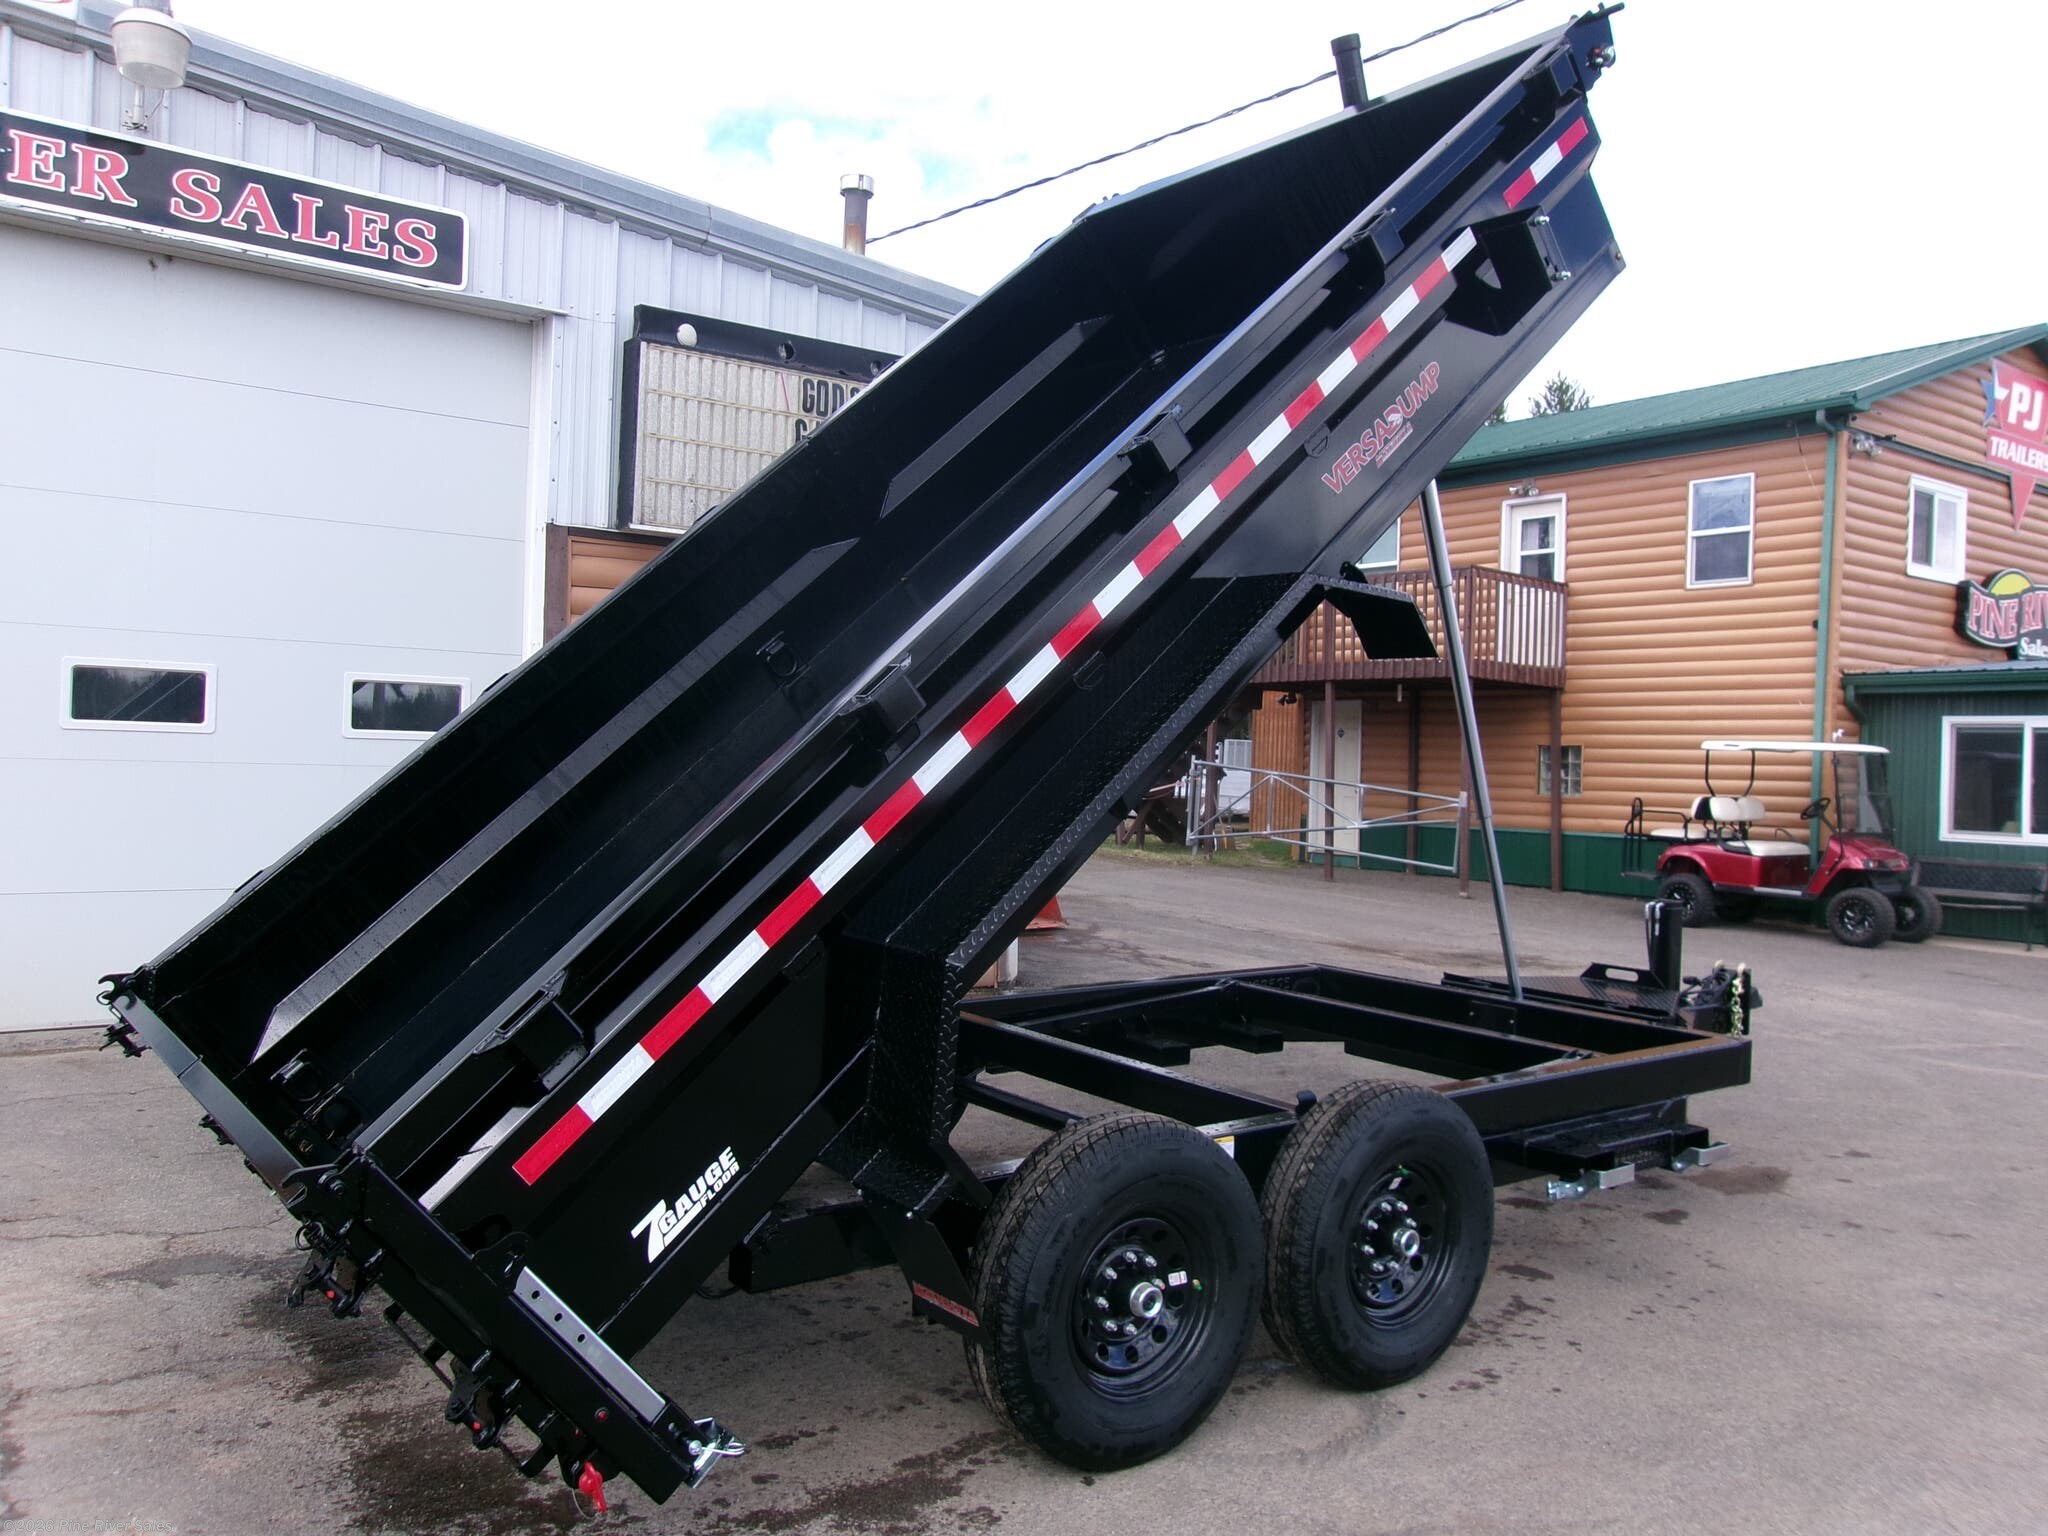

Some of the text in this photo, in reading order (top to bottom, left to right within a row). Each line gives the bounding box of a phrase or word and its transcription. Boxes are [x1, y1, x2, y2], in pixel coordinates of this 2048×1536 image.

[169, 167, 438, 268] SALES
[2007, 381, 2045, 431] PJ
[1967, 586, 2020, 639] PINE
[657, 1145, 737, 1235] GAUGE
[701, 1161, 741, 1208] FLOOR
